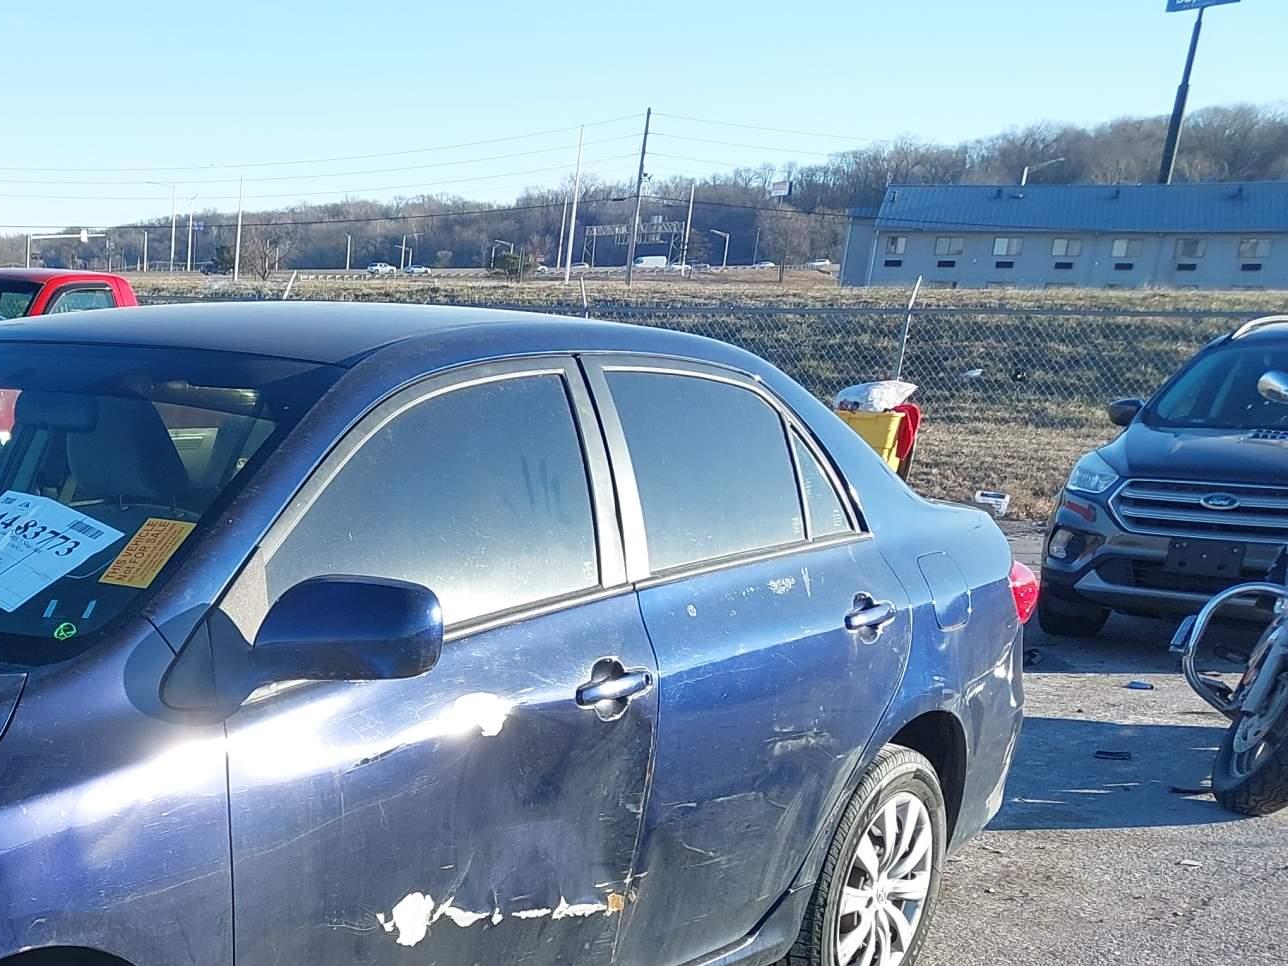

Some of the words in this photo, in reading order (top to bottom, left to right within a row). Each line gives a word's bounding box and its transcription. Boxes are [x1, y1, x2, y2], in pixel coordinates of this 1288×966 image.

[103, 558, 126, 579] THIS
[125, 520, 157, 558] VEHICLE
[117, 565, 133, 581] Not
[132, 545, 150, 566] FOR
[147, 521, 170, 544] SALE
